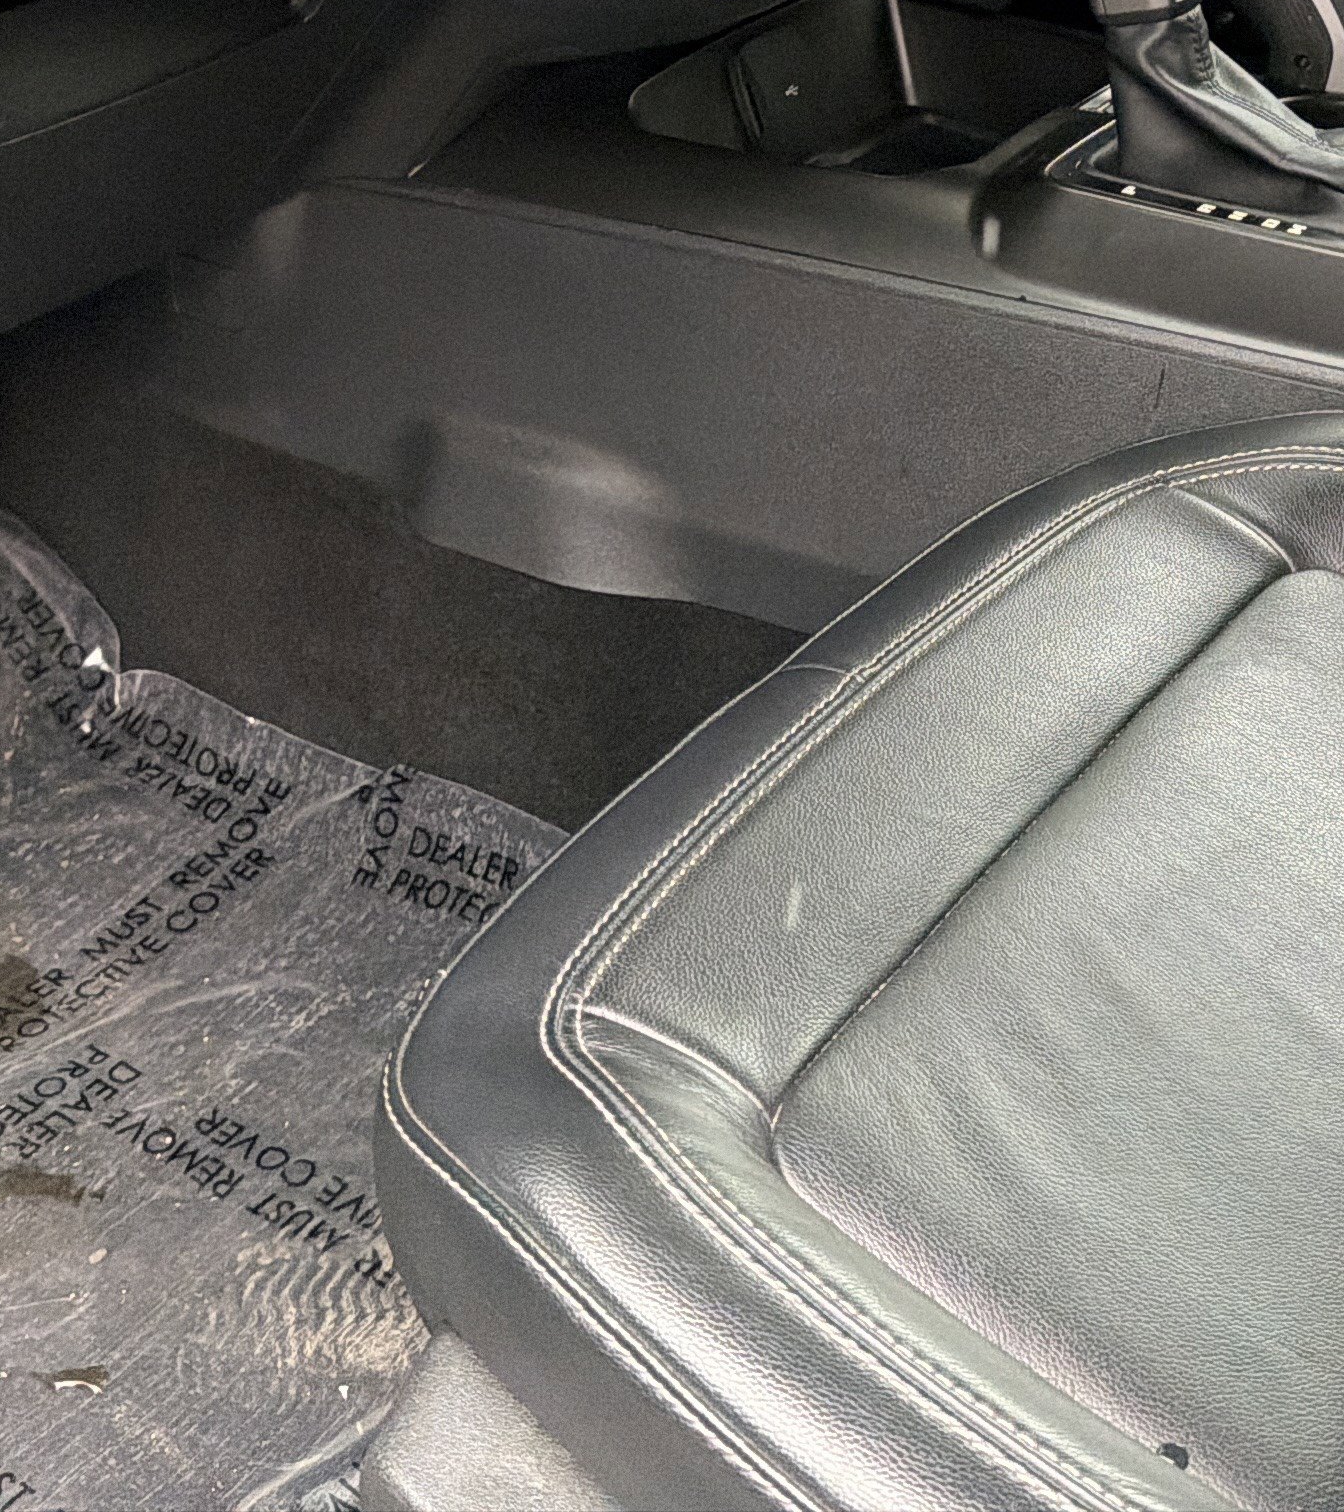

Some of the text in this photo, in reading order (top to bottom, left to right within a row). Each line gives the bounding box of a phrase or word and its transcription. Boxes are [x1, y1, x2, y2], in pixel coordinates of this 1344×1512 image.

[17, 589, 107, 693] COVER
[124, 756, 233, 824] DEALER
[350, 771, 411, 890] MOVE
[80, 895, 164, 962] MUST
[162, 777, 292, 892] REMOVE
[164, 845, 278, 936] COVER
[386, 867, 501, 924] PROTEC
[408, 825, 520, 890] DEALER
[7, 1058, 144, 1161] DEALER
[100, 1106, 247, 1202] REMOVE
[193, 1105, 319, 1189] COVER
[244, 1191, 351, 1254] MUST
